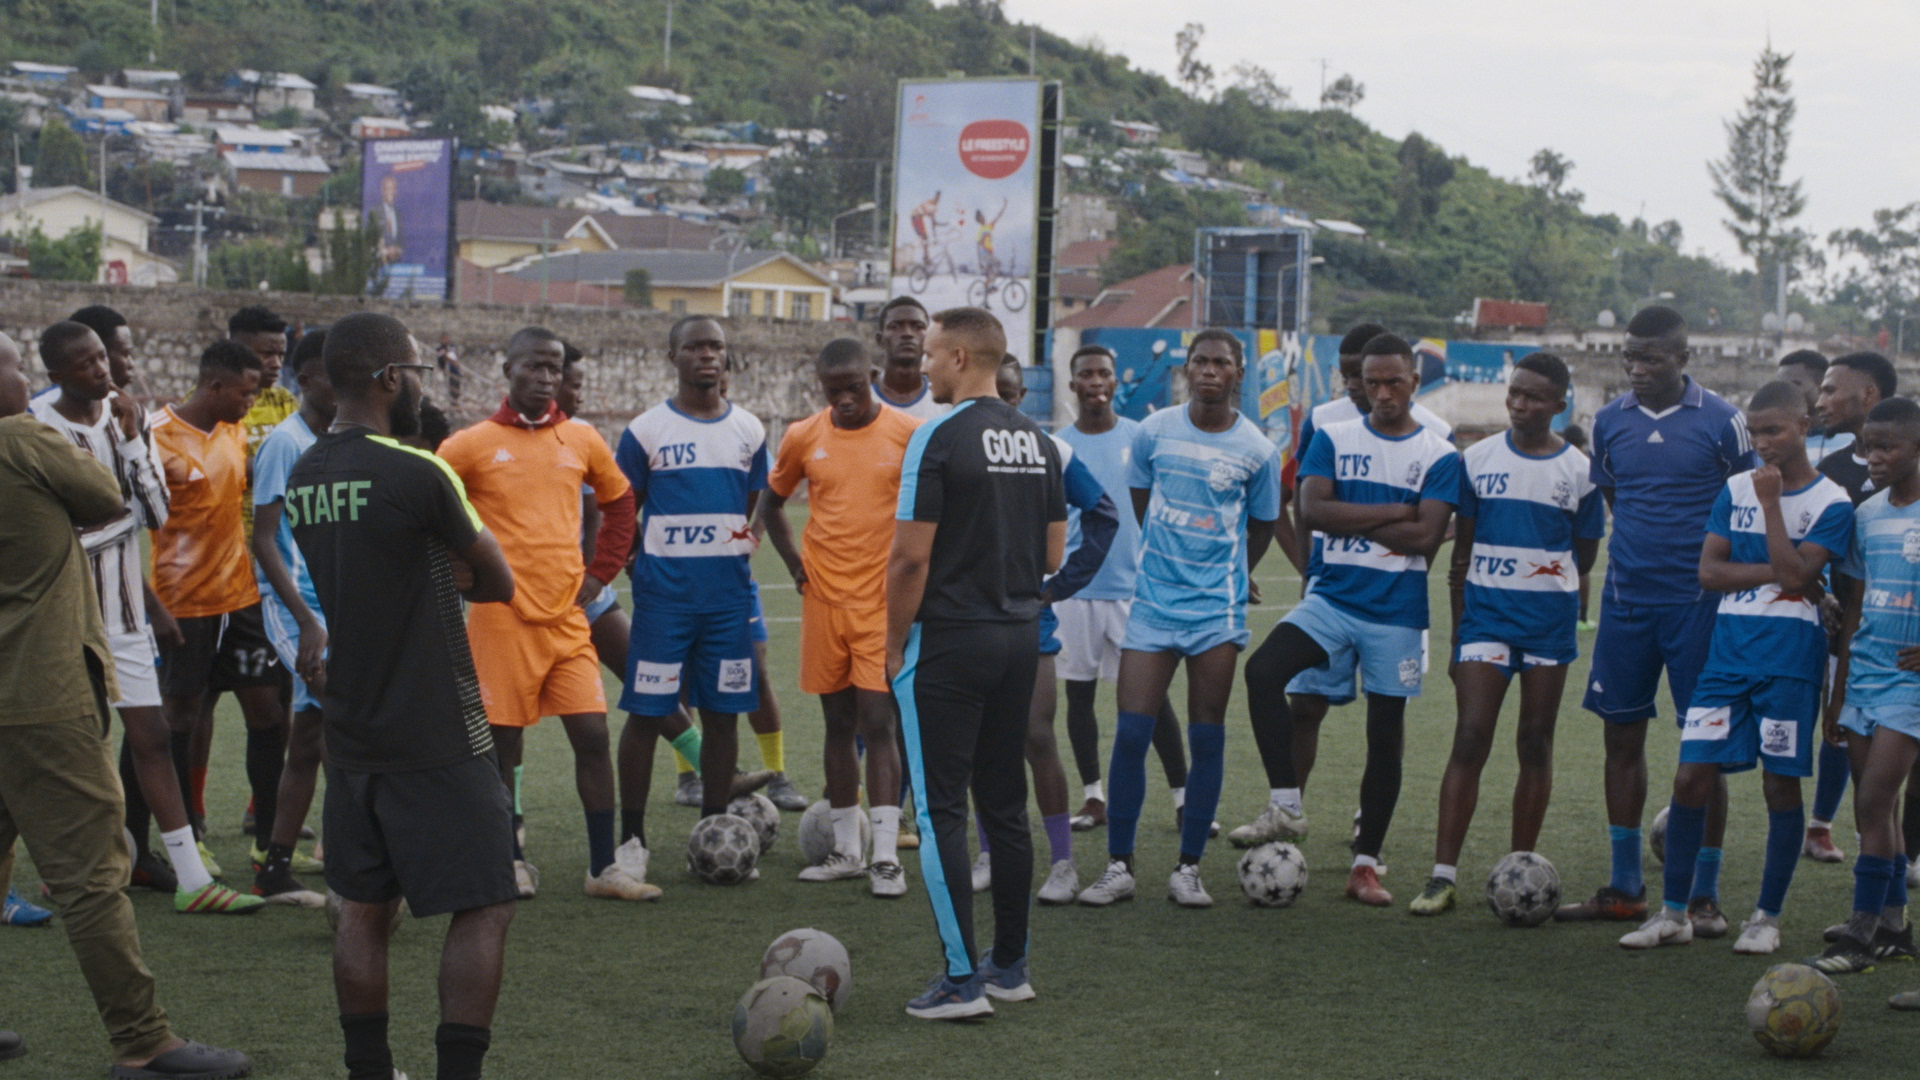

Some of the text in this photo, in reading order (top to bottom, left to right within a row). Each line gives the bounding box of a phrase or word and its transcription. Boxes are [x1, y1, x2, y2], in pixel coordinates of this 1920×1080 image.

[659, 443, 696, 467] TVS
[982, 429, 1046, 465] GOAL
[1339, 454, 1372, 477] TVS
[1476, 473, 1509, 496] TVS
[286, 481, 372, 528] STAFF
[1159, 505, 1191, 527] TVS
[664, 526, 717, 545] TVS
[1475, 555, 1518, 576] TVS
[638, 673, 661, 683] TVS
